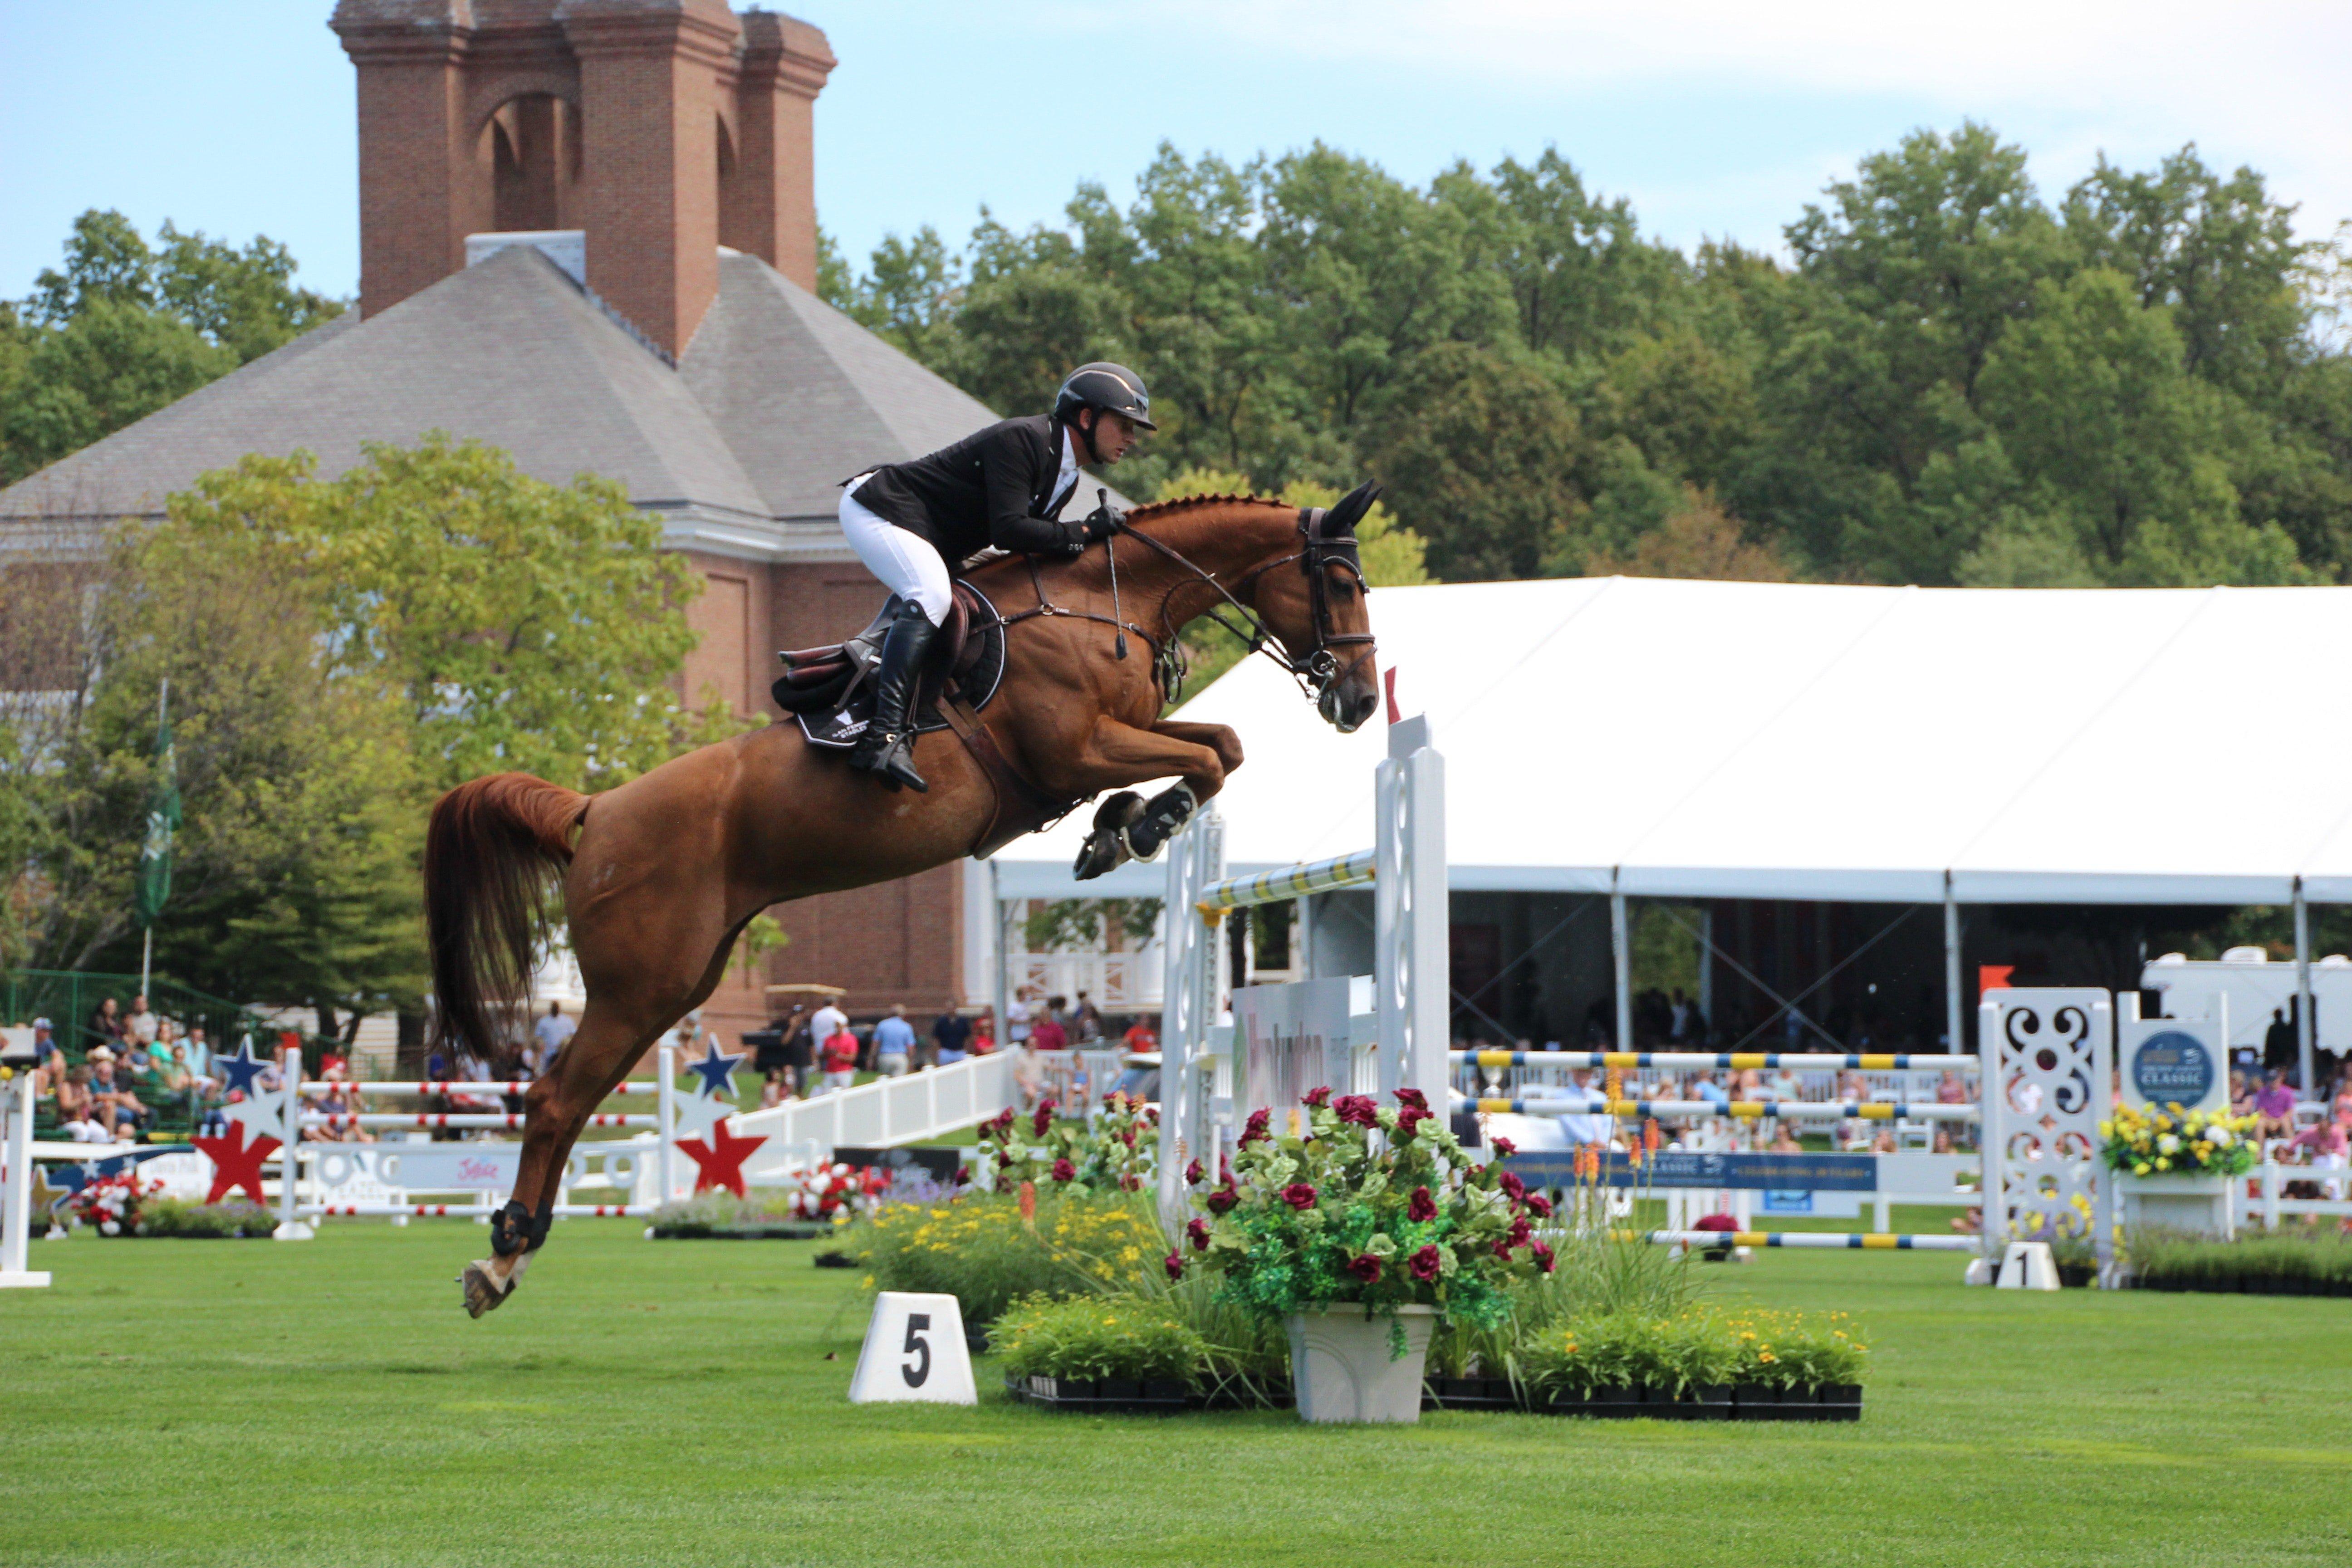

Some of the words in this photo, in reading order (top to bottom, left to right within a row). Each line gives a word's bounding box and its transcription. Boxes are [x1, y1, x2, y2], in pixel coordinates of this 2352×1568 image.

[2140, 1071, 2202, 1085] CLASSIC
[2016, 1251, 2028, 1285] 1
[902, 1313, 930, 1388] 5
